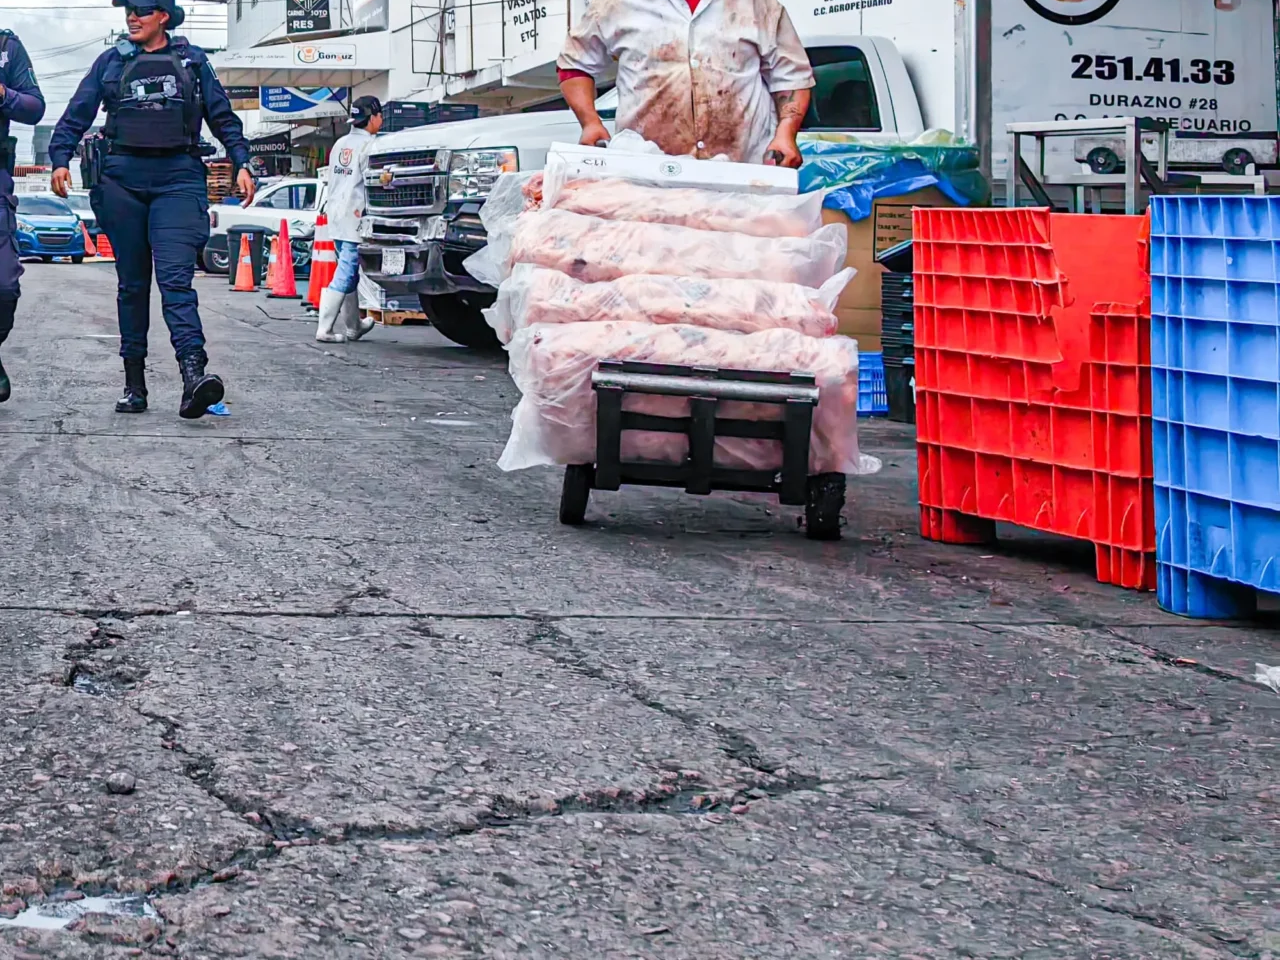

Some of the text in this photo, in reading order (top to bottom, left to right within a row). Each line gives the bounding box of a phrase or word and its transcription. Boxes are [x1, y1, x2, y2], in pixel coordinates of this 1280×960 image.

[513, 7, 547, 26] PLATOS
[814, 8, 827, 16] C.C.
[292, 20, 314, 29] RES
[521, 30, 539, 43] ETC.
[1071, 54, 1235, 85] 251.41.33
[1089, 93, 1218, 110] DURAZNO #28
[249, 143, 286, 153] NVENIDOS
